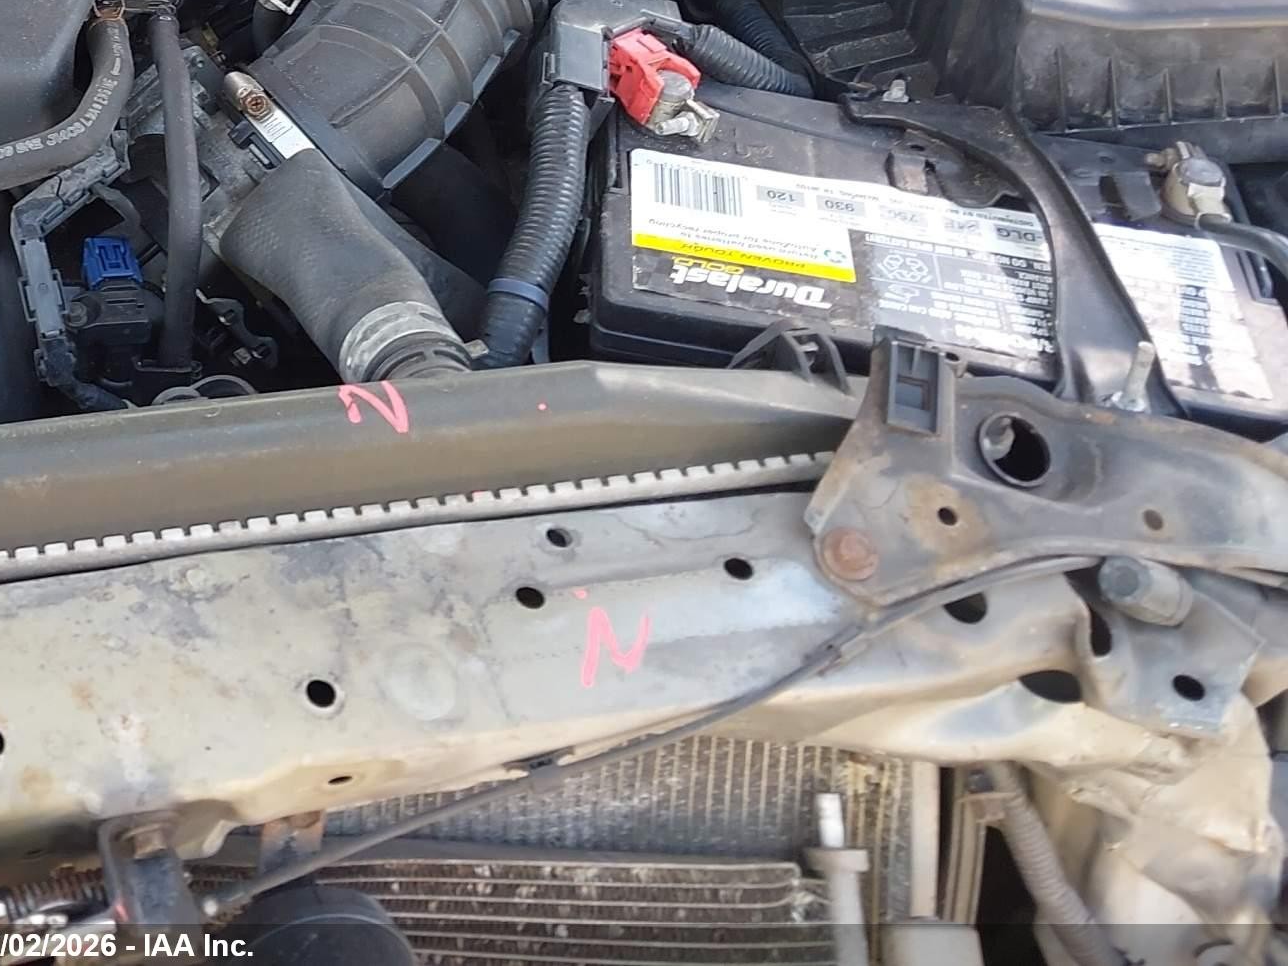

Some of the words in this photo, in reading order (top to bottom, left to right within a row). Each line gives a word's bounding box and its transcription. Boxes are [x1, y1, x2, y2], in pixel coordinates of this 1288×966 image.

[767, 190, 795, 202] 120
[825, 200, 855, 212] 930
[669, 264, 833, 309] Duralast
[339, 381, 409, 434] N
[580, 607, 652, 687] N
